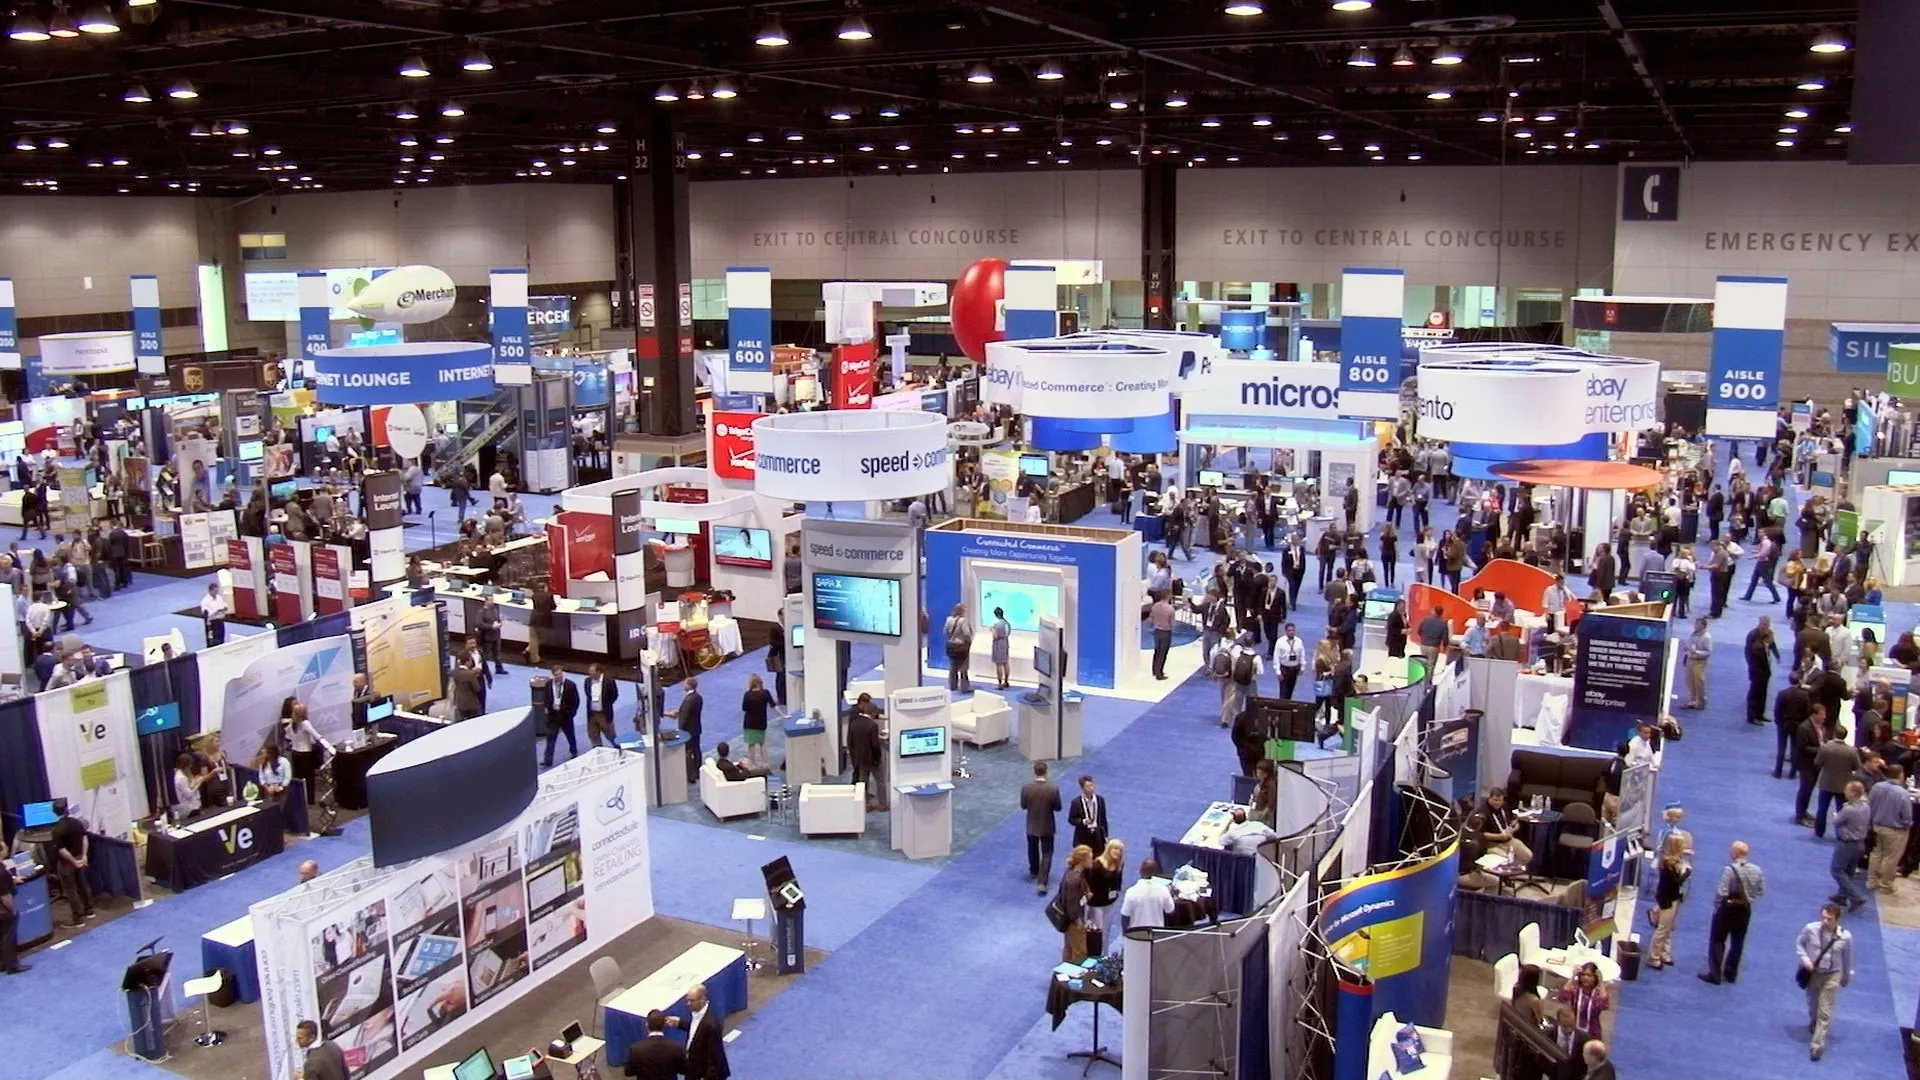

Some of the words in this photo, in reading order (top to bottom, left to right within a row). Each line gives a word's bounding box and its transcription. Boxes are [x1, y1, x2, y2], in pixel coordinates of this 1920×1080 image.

[636, 139, 645, 151] H
[675, 139, 684, 151] H
[634, 155, 648, 168] 32
[675, 155, 686, 168] 32
[753, 231, 788, 247] EXIT
[796, 231, 815, 246] TO
[824, 230, 898, 246] CENTRAL
[909, 229, 1019, 245] CONCOURSE
[1223, 229, 1269, 246] EXIT
[1279, 229, 1303, 246] TO
[1315, 230, 1412, 247] CENTRAL
[1425, 230, 1565, 248] CONCOURSE
[1705, 231, 1872, 251] EMERGENCY
[501, 336, 523, 344] AISLE
[738, 340, 762, 348] AISLE
[306, 342, 328, 353] 400
[500, 345, 525, 357] 500
[735, 350, 765, 363] 600
[1353, 355, 1387, 365] AISLE
[343, 371, 412, 387] LOUNGE
[1349, 367, 1390, 382] 800
[1724, 370, 1765, 381] AISLE
[1115, 380, 1157, 393] Creating
[1586, 372, 1628, 401] ebay
[1719, 382, 1767, 400] 900
[860, 449, 910, 479] speed
[810, 543, 834, 558] speed
[844, 549, 904, 561] commerce
[1598, 654, 1608, 662] THE
[1609, 648, 1651, 658] MANAGEMENT
[1584, 689, 1606, 700] ebay
[1584, 697, 1627, 709] enterprise
[80, 722, 107, 745] Ve
[217, 822, 254, 855] Ve
